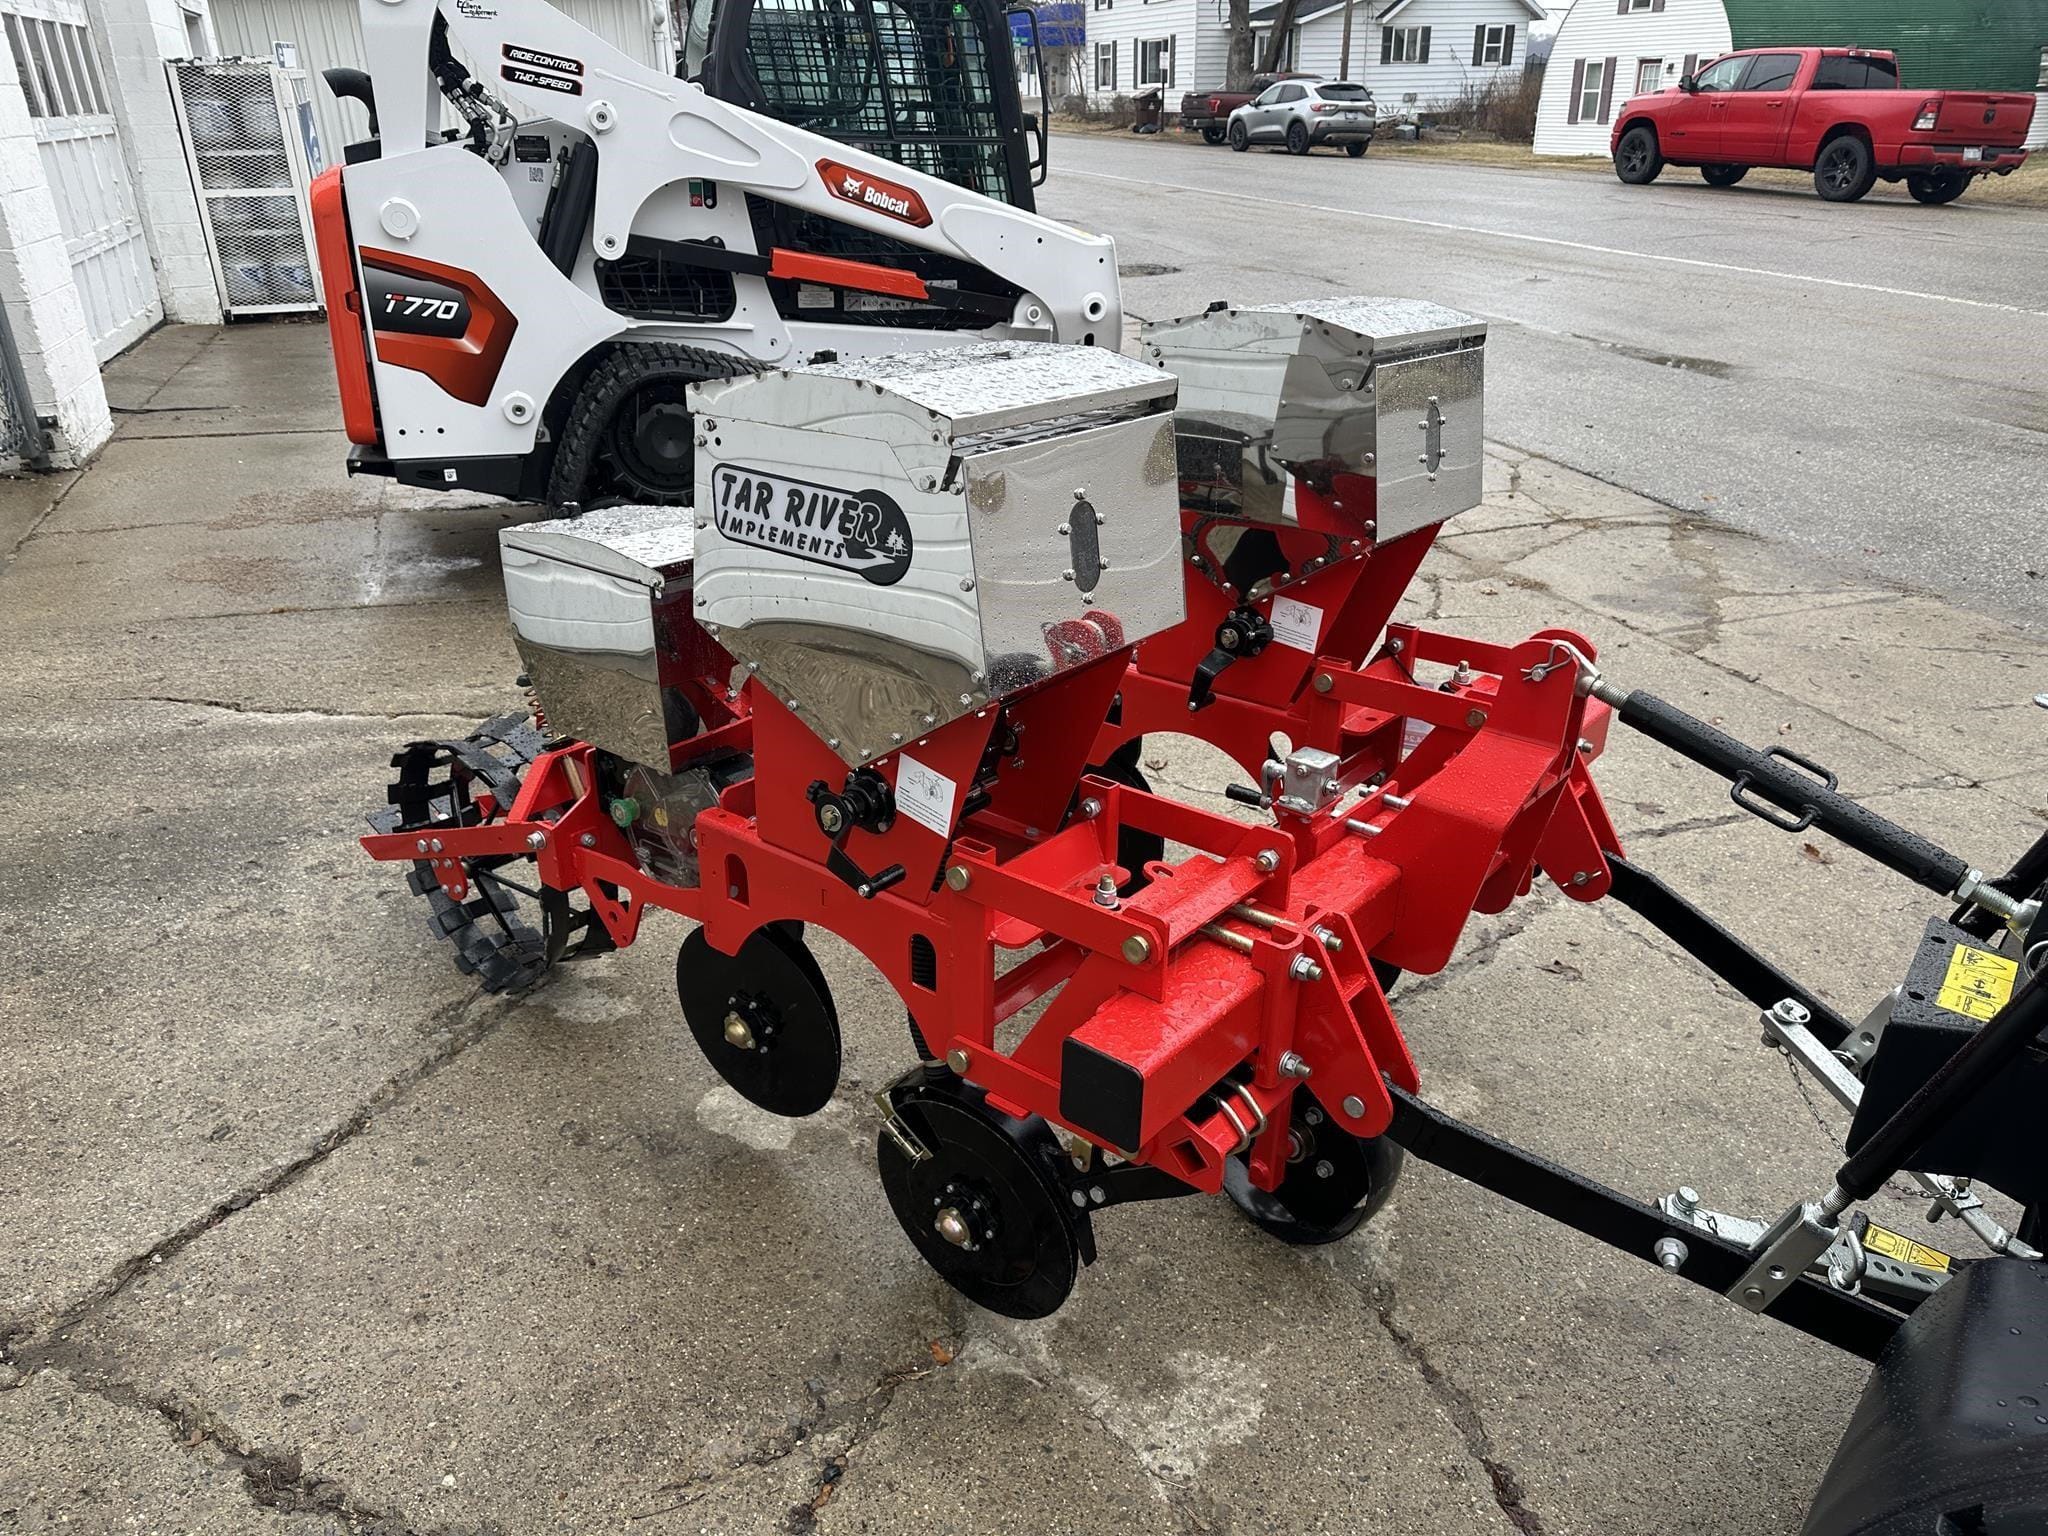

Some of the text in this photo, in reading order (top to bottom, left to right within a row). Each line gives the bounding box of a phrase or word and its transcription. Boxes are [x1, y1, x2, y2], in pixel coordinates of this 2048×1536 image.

[509, 49, 579, 72] RIDE CONTROL
[514, 71, 573, 90] TWO-SPEED
[863, 186, 910, 216] Bobcat
[385, 293, 460, 319] T770
[721, 472, 880, 547] TAR RIVER
[720, 510, 846, 559] IMPLEMENTS
